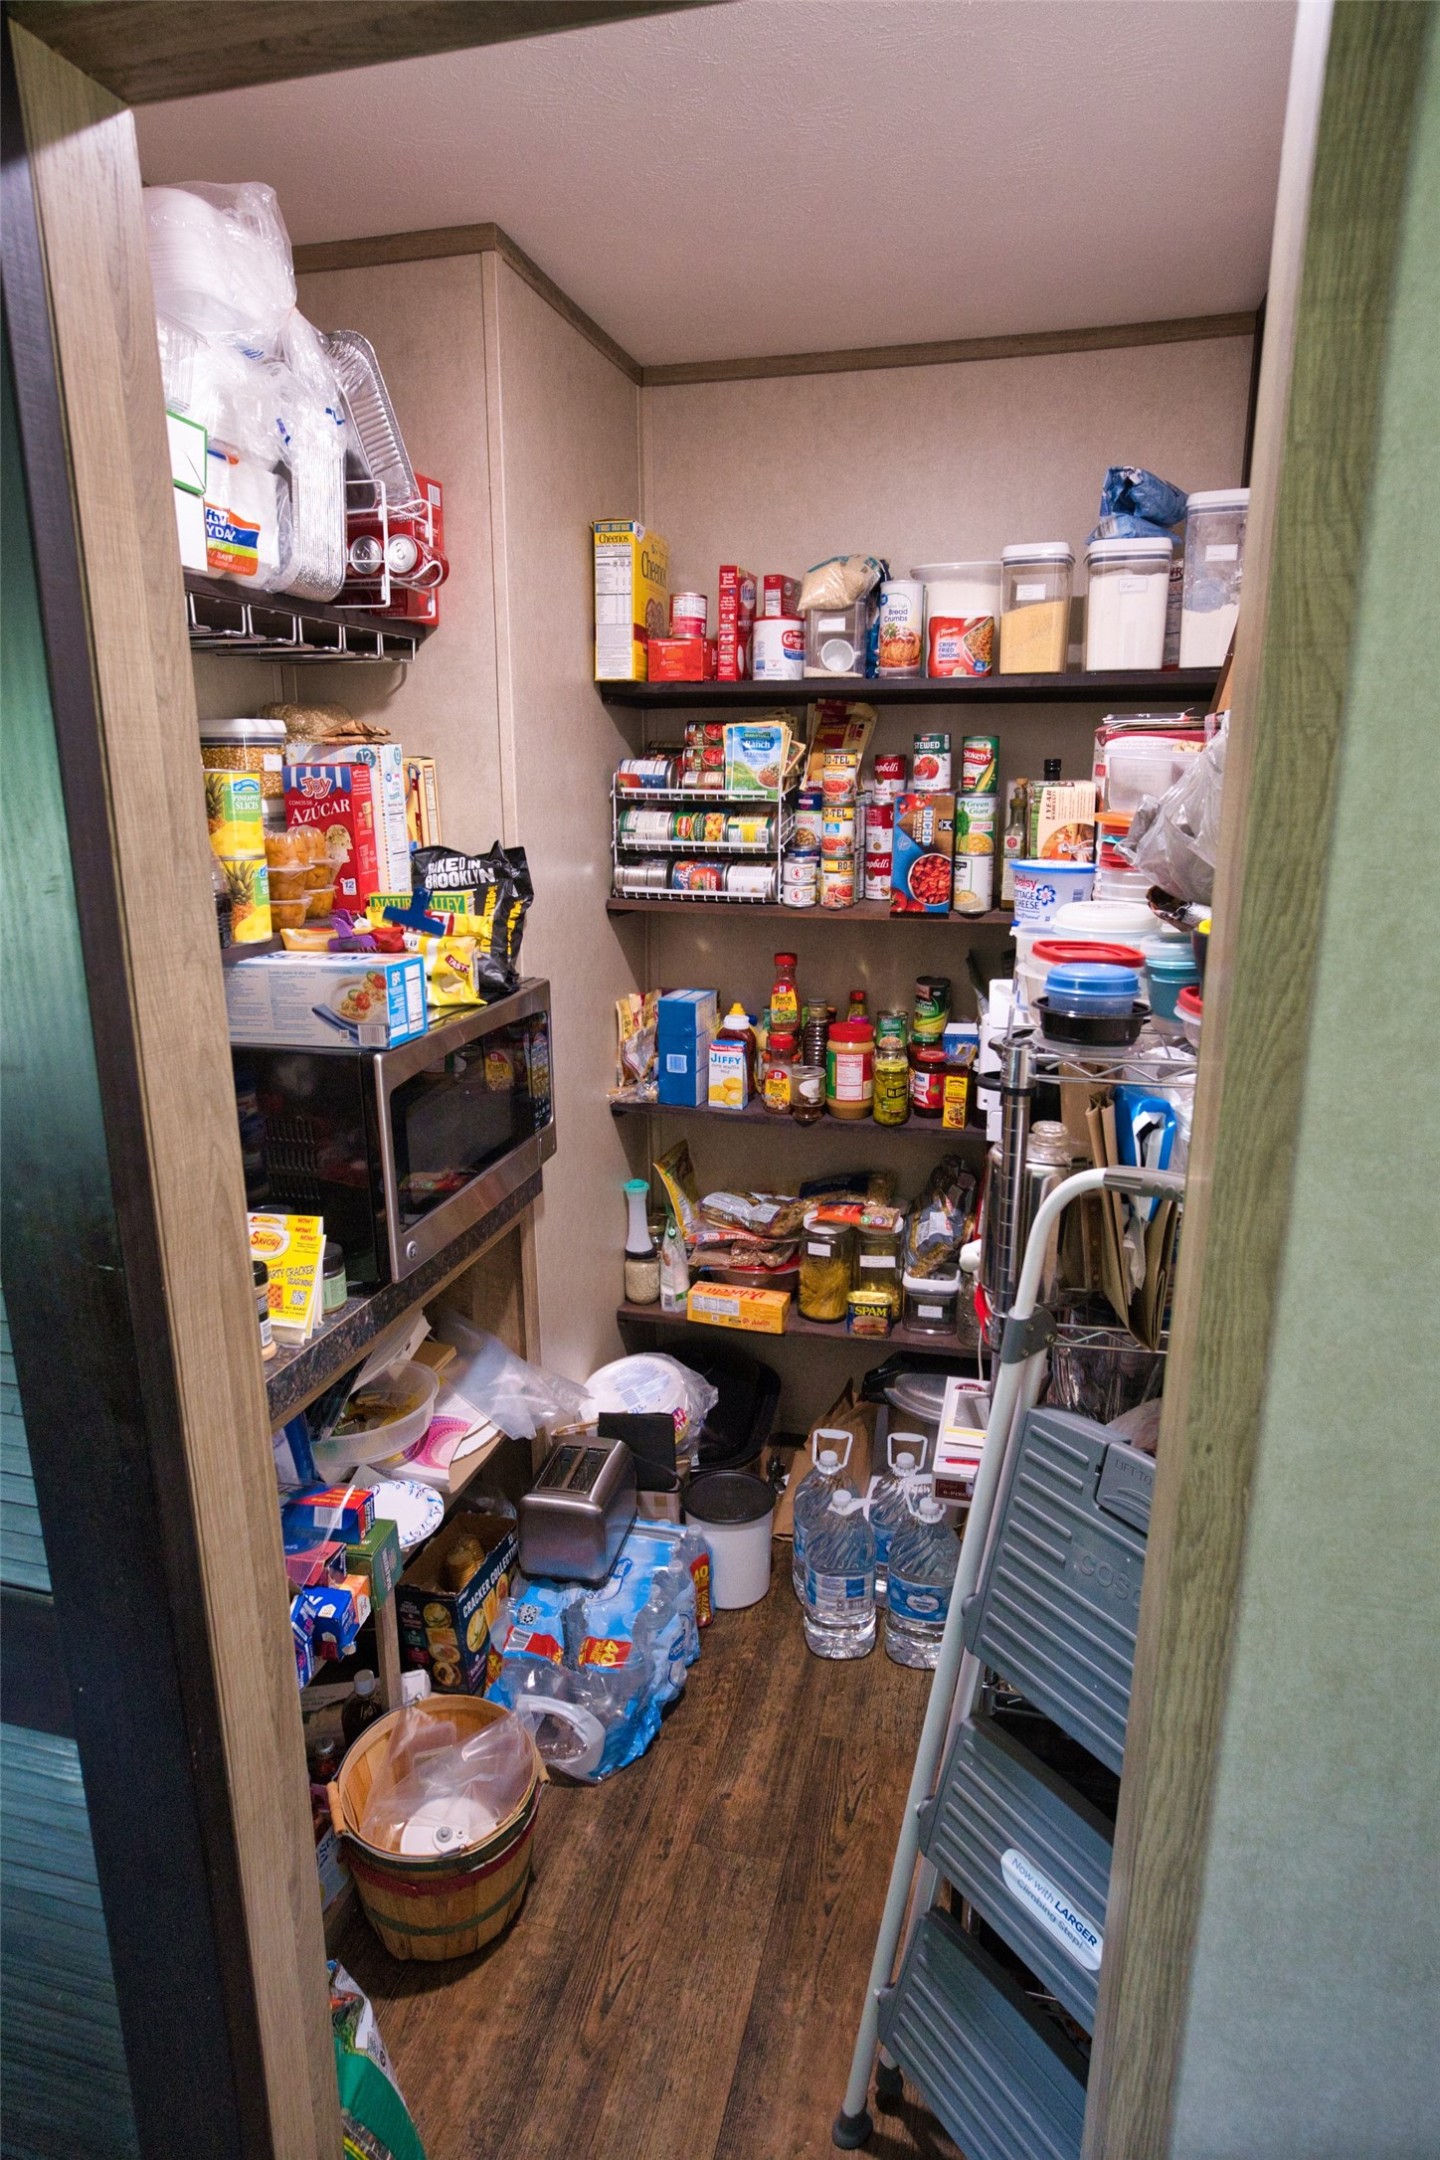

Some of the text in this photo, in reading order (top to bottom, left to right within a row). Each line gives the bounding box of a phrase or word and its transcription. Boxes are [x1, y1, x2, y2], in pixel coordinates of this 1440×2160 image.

[598, 533, 629, 544] Cheerios
[359, 750, 371, 760] 12
[300, 775, 333, 799] Joy
[290, 799, 351, 825] AZÚCAR
[922, 809, 933, 844] DICED
[468, 859, 481, 869] IN
[345, 881, 354, 889] 12
[425, 867, 495, 889] BROOKLYN
[374, 896, 463, 912] NATUR ALLEY
[710, 1053, 741, 1065] JIFFY
[268, 1268, 285, 1279] ARTY
[285, 1264, 315, 1278] CRACKER
[705, 1286, 767, 1300] Velveeta
[854, 1305, 888, 1316] SPAM
[1115, 1458, 1135, 1478] LIFT
[693, 1564, 709, 1583] 40
[462, 1577, 491, 1618] CRACKER
[1012, 1857, 1098, 1947] Now with LARGER
[1016, 1878, 1084, 1949] Climbing Step!
